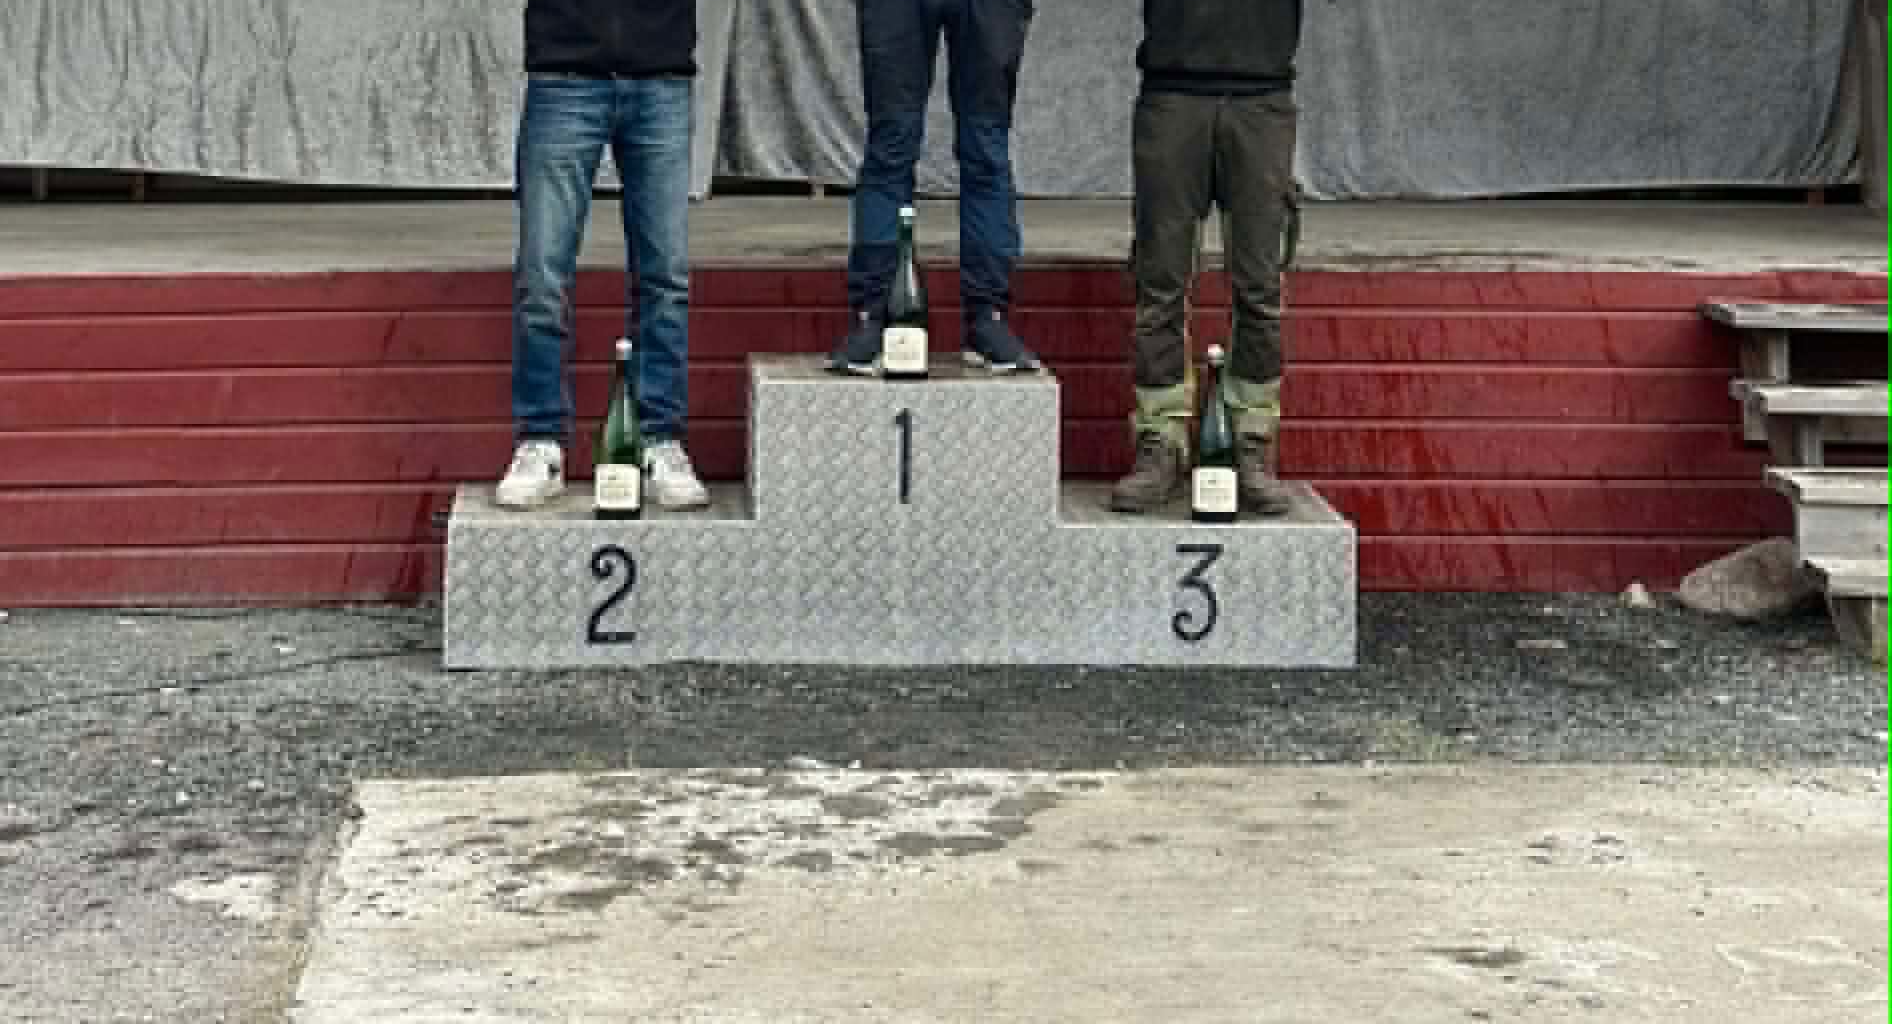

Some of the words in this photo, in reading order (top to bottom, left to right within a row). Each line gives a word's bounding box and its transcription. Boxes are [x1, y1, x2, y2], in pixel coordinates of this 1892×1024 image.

[896, 407, 914, 505] 1
[586, 545, 637, 645] 2
[1172, 543, 1226, 642] 3
